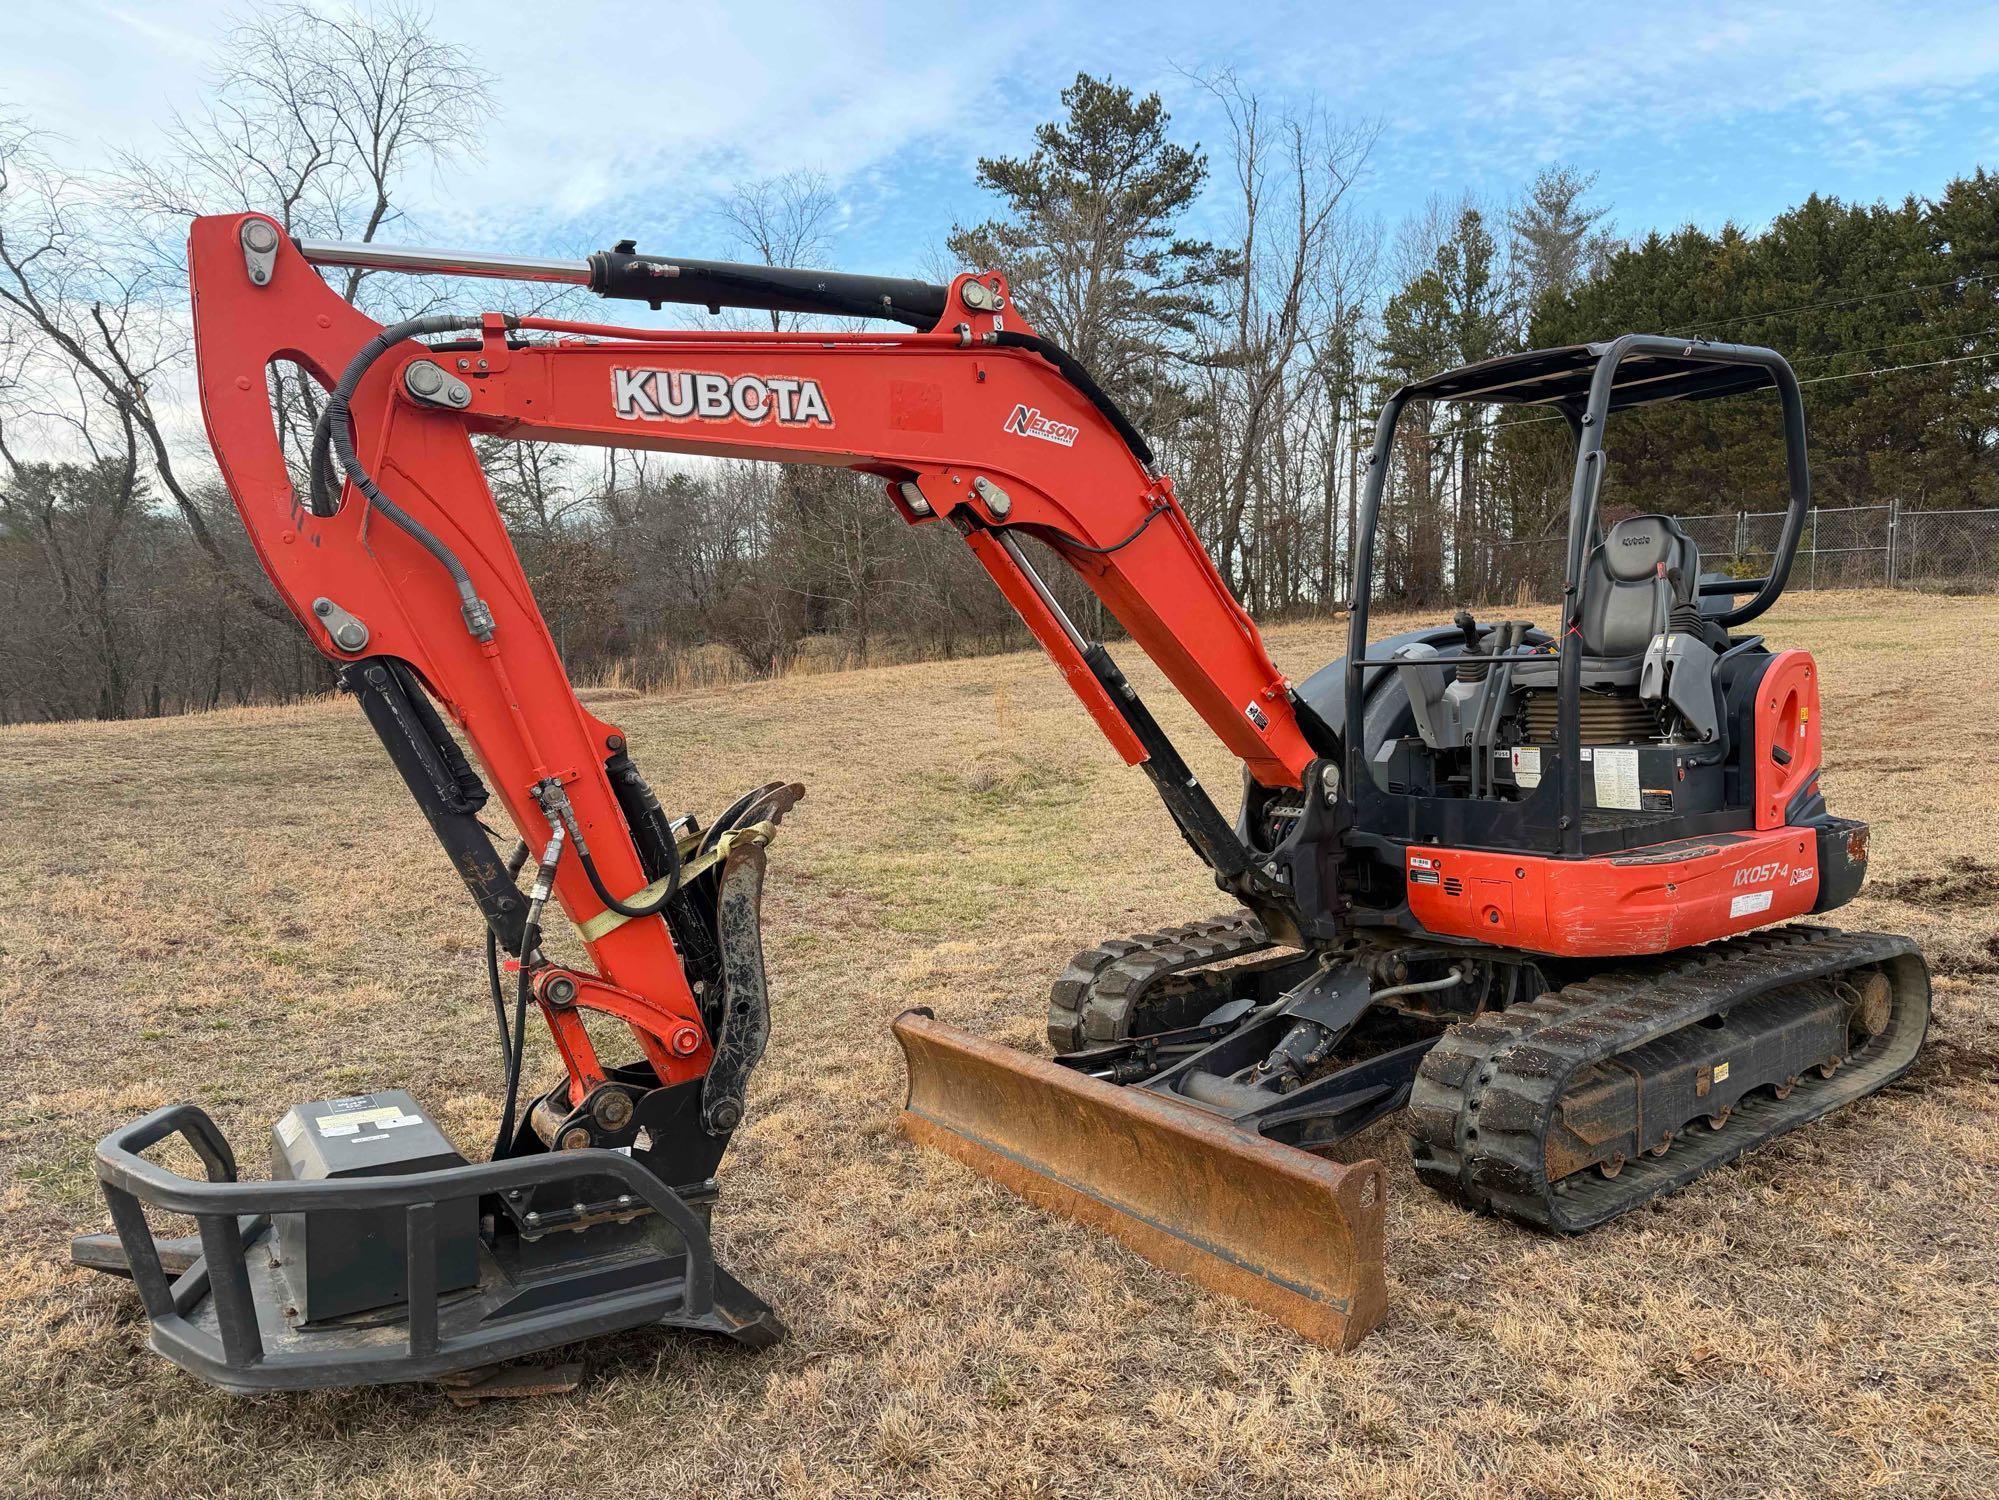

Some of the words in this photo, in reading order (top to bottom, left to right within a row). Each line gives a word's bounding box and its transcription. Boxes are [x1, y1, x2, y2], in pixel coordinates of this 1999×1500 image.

[614, 368, 833, 424] KUBOTA
[1622, 535, 1651, 547] Kubota
[1733, 862, 1789, 888] KX057-4
